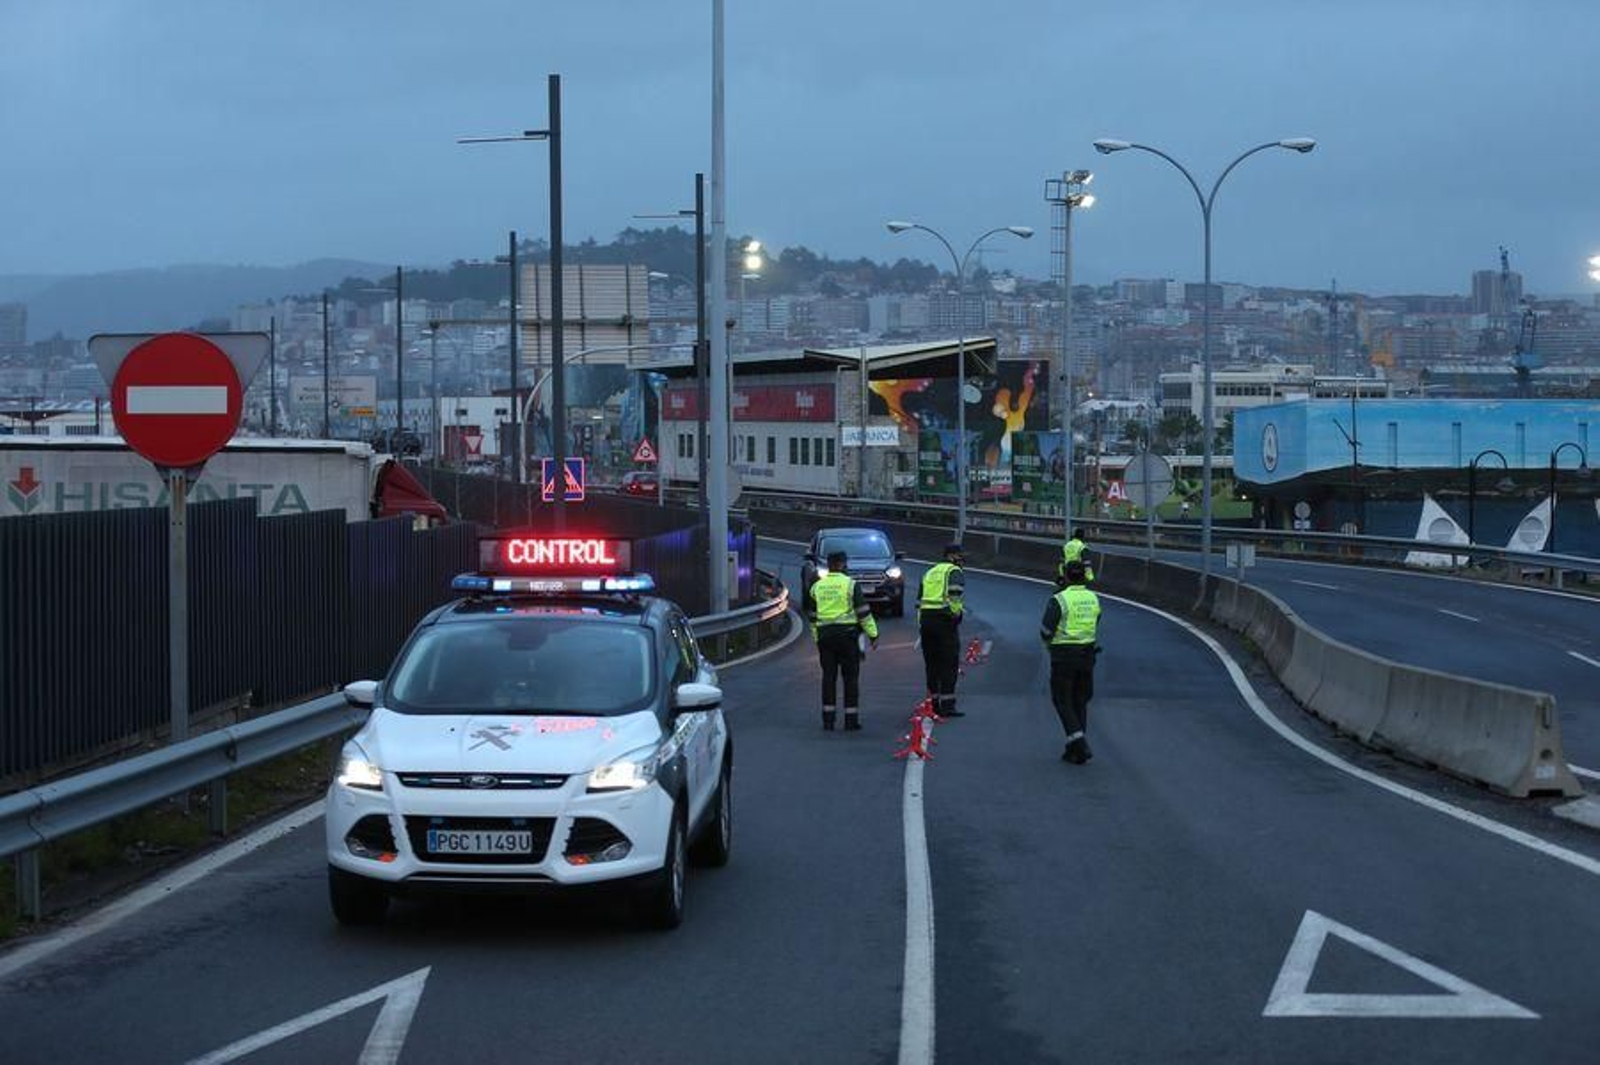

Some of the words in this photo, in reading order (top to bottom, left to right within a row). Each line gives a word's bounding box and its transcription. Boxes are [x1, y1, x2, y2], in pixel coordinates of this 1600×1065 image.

[850, 430, 896, 441] AANCA
[55, 481, 311, 514] HISNTA
[508, 539, 615, 564] CONTROL
